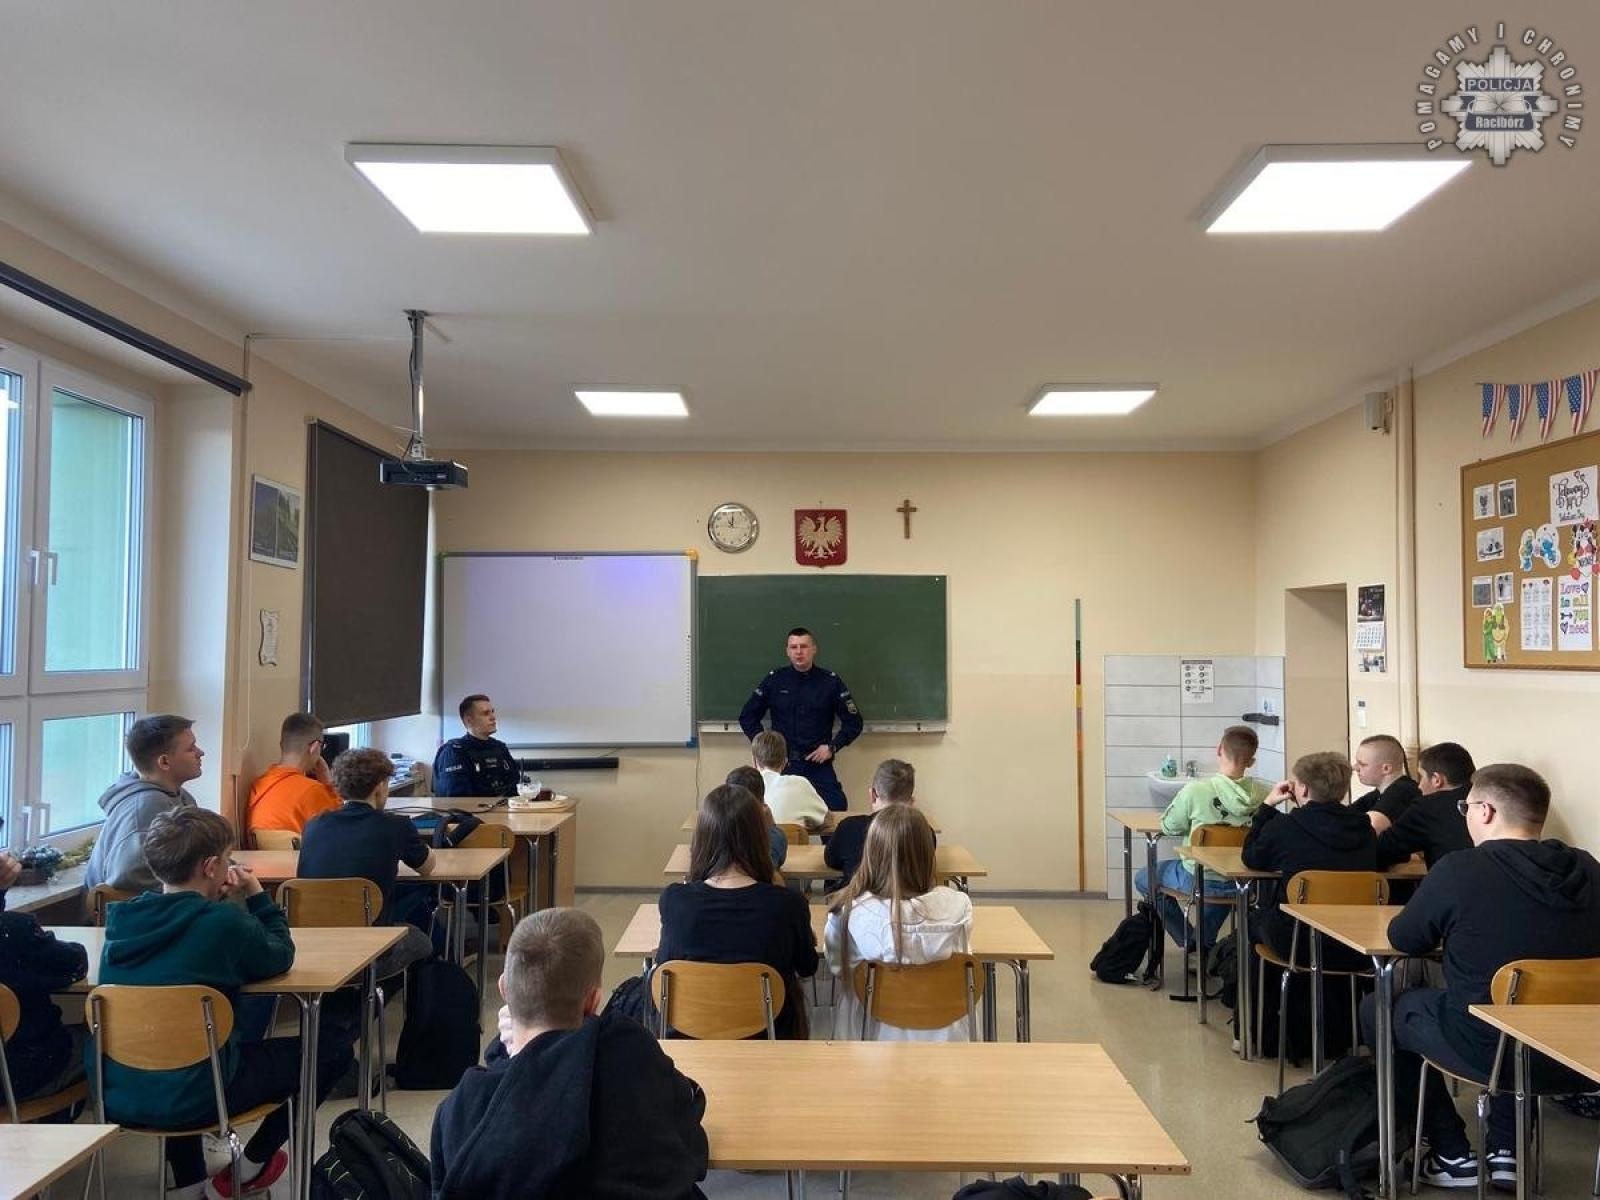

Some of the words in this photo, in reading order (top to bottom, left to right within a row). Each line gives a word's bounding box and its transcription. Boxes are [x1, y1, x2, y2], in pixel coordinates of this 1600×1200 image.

[1560, 583, 1581, 595] Love
[1573, 609, 1589, 624] you
[1568, 621, 1589, 634] need
